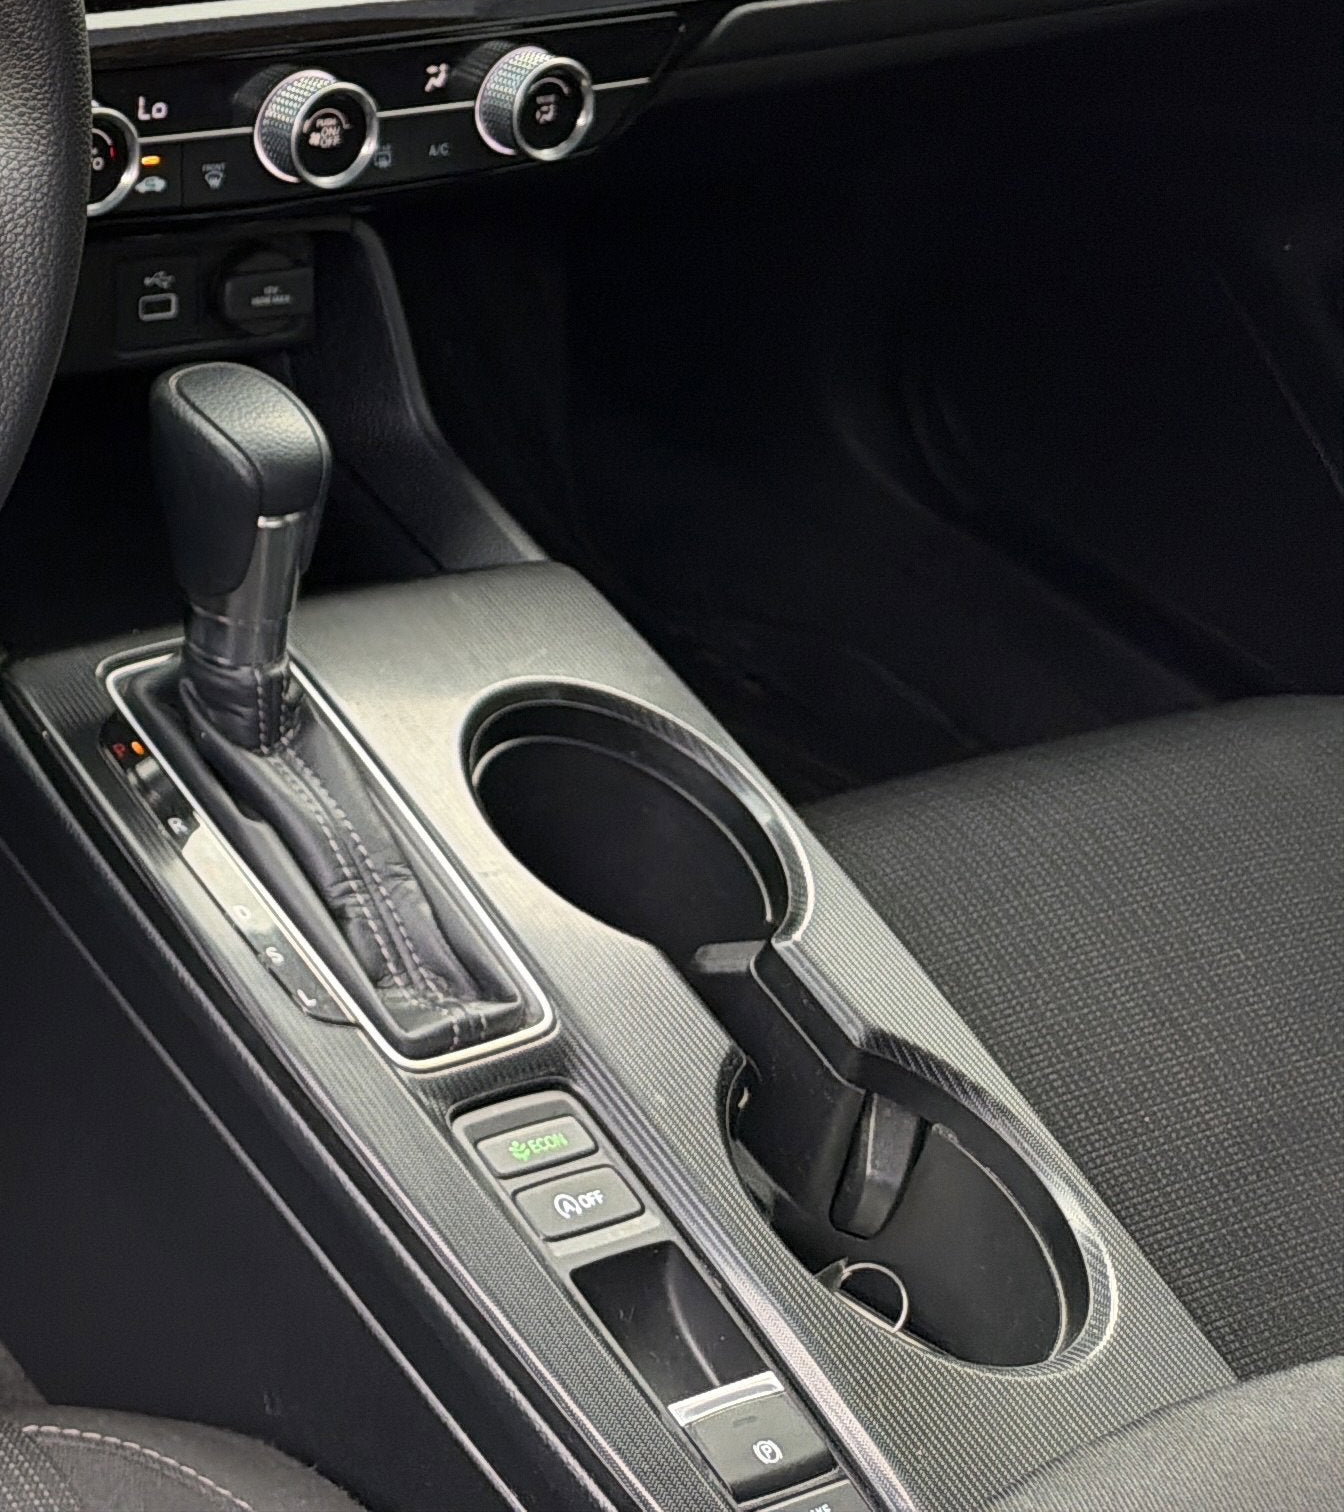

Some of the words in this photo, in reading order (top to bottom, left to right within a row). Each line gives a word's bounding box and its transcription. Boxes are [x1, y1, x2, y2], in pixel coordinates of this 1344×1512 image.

[137, 95, 169, 121] Lo
[320, 136, 342, 149] OFF
[428, 142, 450, 157] A/C
[167, 817, 189, 835] R
[265, 945, 285, 966] S
[297, 988, 317, 1008] L
[528, 1131, 569, 1155] ECON
[577, 1188, 605, 1209] OFF
